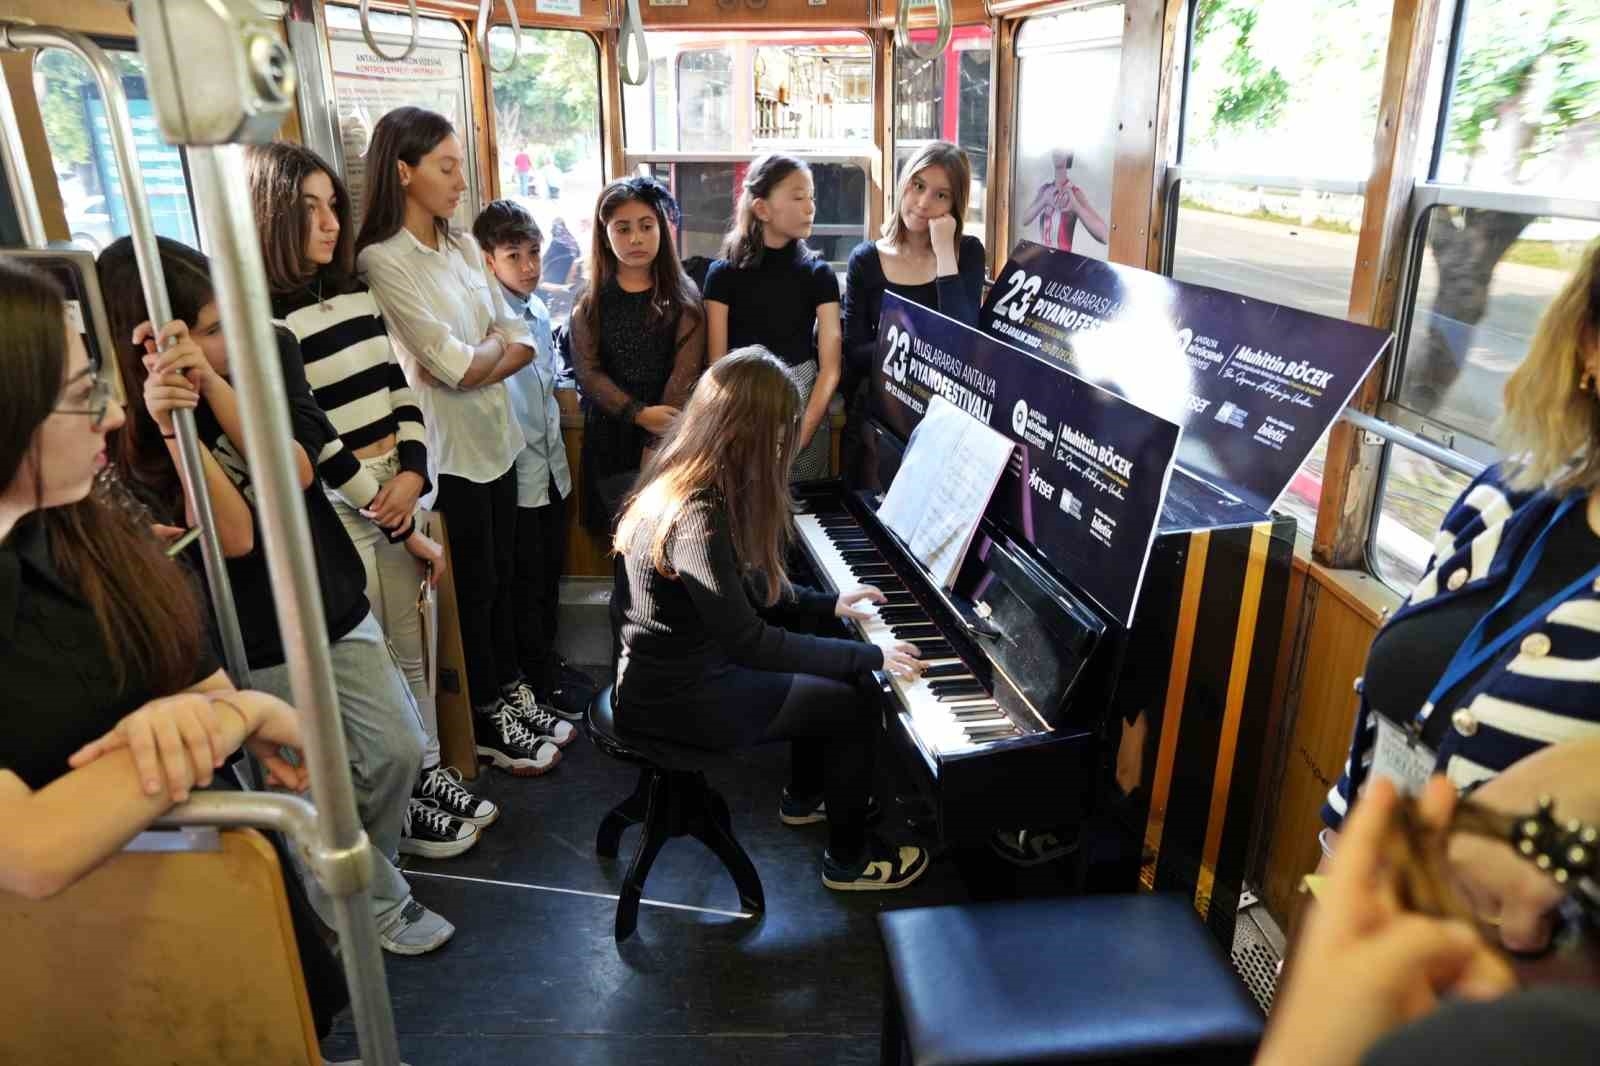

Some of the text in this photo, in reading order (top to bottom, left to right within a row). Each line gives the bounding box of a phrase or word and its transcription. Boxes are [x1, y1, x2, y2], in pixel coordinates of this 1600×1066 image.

[992, 269, 1042, 323] 23.
[1045, 280, 1112, 314] ULUSLARARASI
[882, 325, 911, 386] 23.
[913, 336, 997, 399] ULUSLARARASI ANTALYA
[1235, 345, 1287, 374] Muhittin
[1284, 360, 1334, 389] BÖCEK
[1060, 424, 1098, 459] Muhittin
[1098, 445, 1134, 480] BÖCEK
[1091, 515, 1113, 539] biletix
